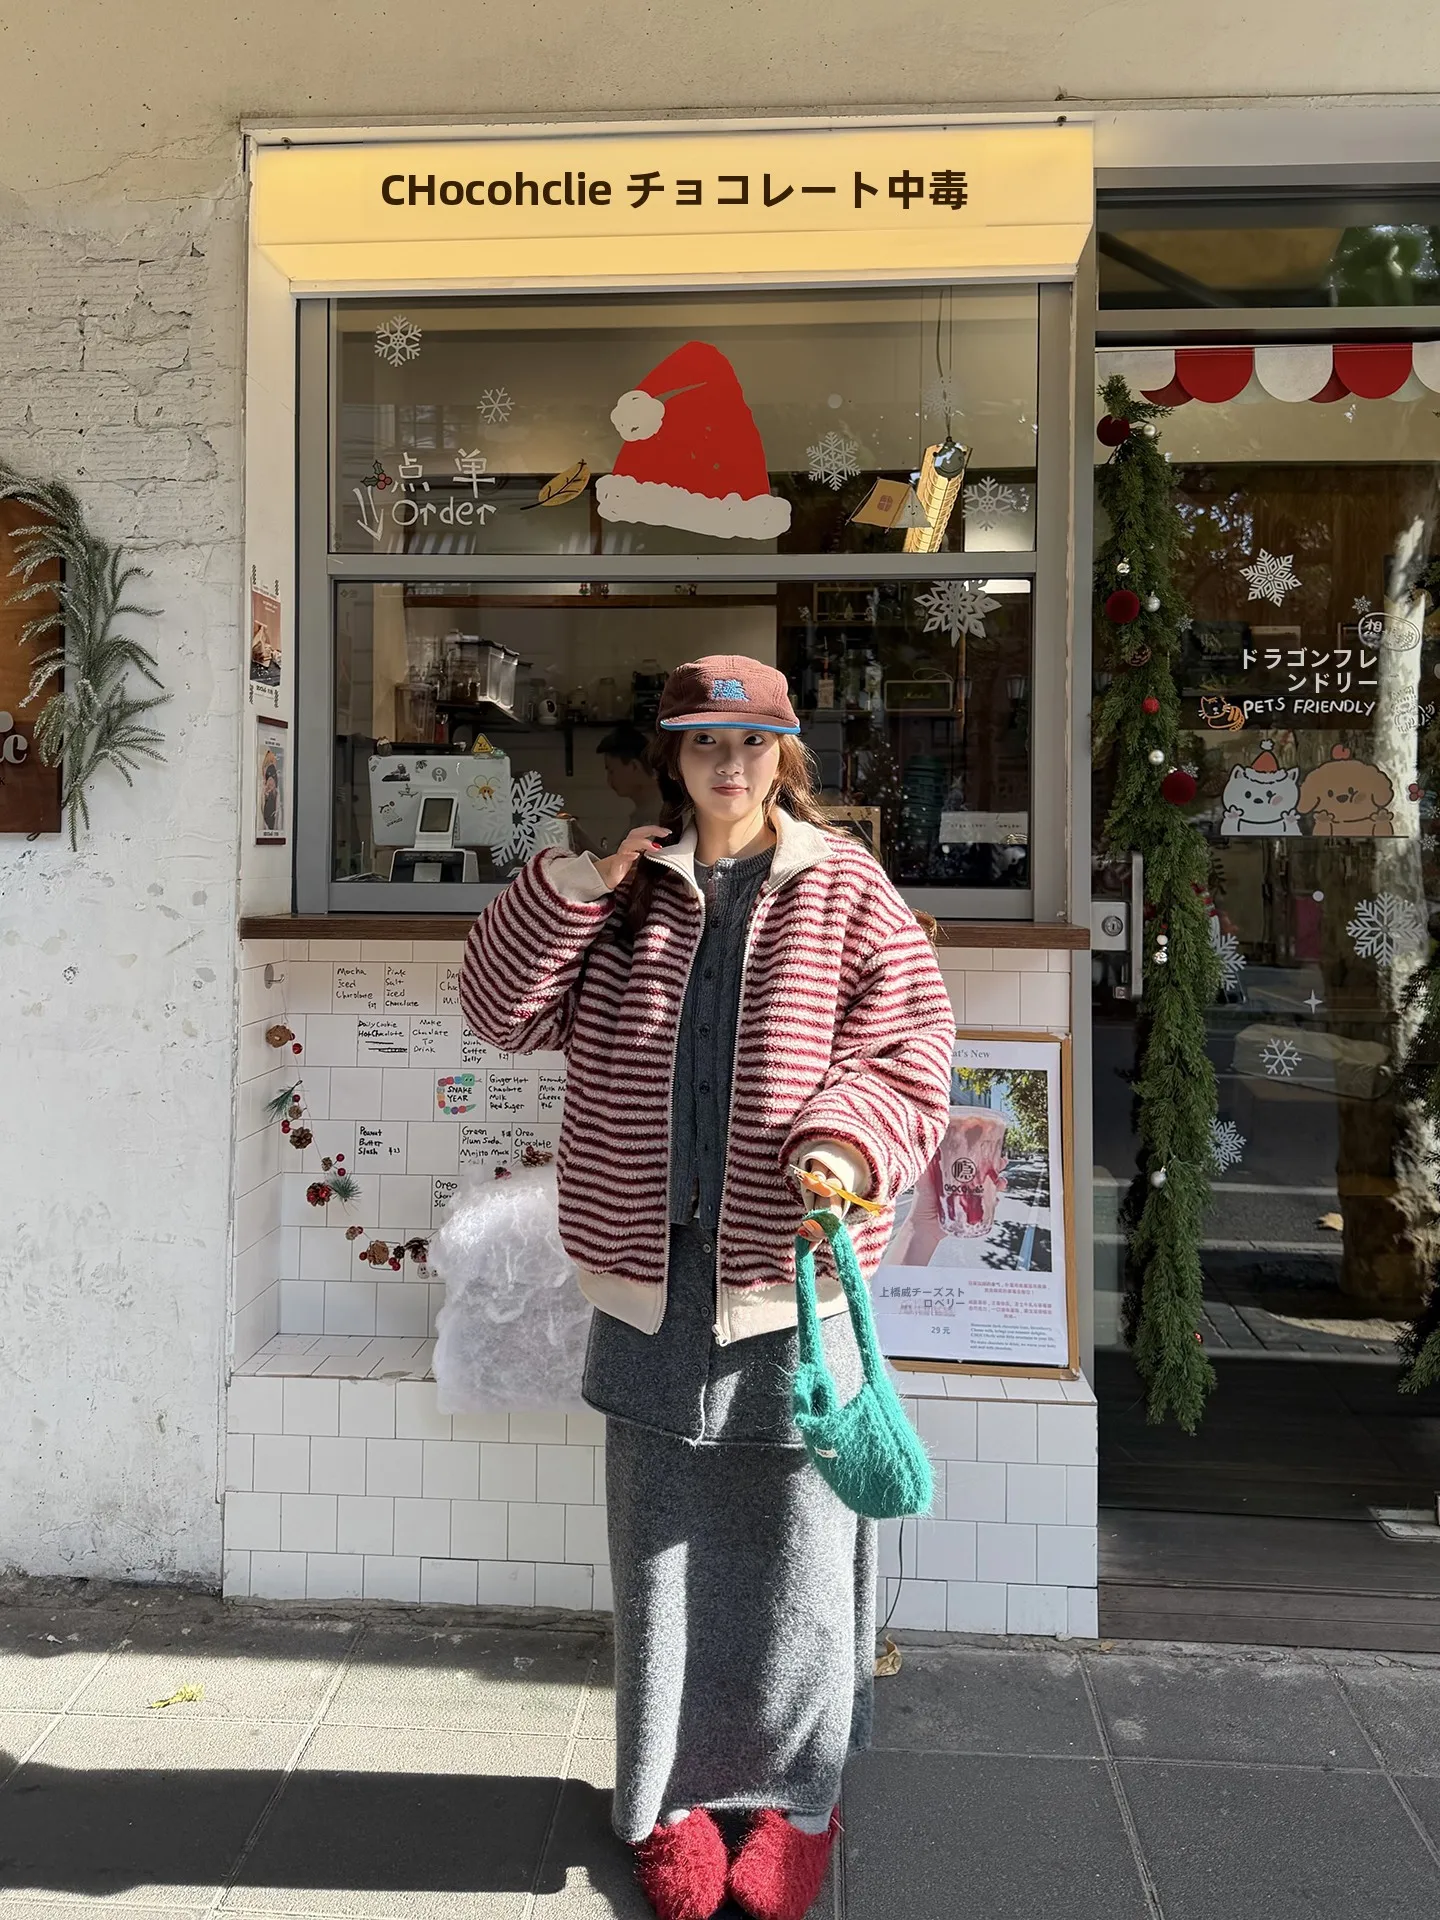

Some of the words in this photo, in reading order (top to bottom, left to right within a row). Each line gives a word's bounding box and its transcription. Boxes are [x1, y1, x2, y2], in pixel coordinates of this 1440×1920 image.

[381, 171, 612, 209] CHocohclie
[626, 170, 969, 211] チョコレート中毒
[391, 448, 496, 498] 点单
[391, 496, 497, 526] Order
[1243, 647, 1378, 670] ドラゴンフレ
[1288, 672, 1378, 694] ンドリー
[1243, 696, 1286, 720] PETS
[1293, 699, 1376, 717] FRIENDLY
[337, 967, 367, 976] Mocha
[970, 1049, 991, 1058] New
[447, 1086, 472, 1094] SNAKE
[447, 1094, 469, 1103] YEAR
[462, 1125, 488, 1135] Green
[515, 1127, 534, 1137] Oreo
[435, 1179, 458, 1191] Oreo
[924, 1299, 966, 1308] ロベリー
[931, 1326, 941, 1334] 29
[942, 1326, 951, 1335] 元
